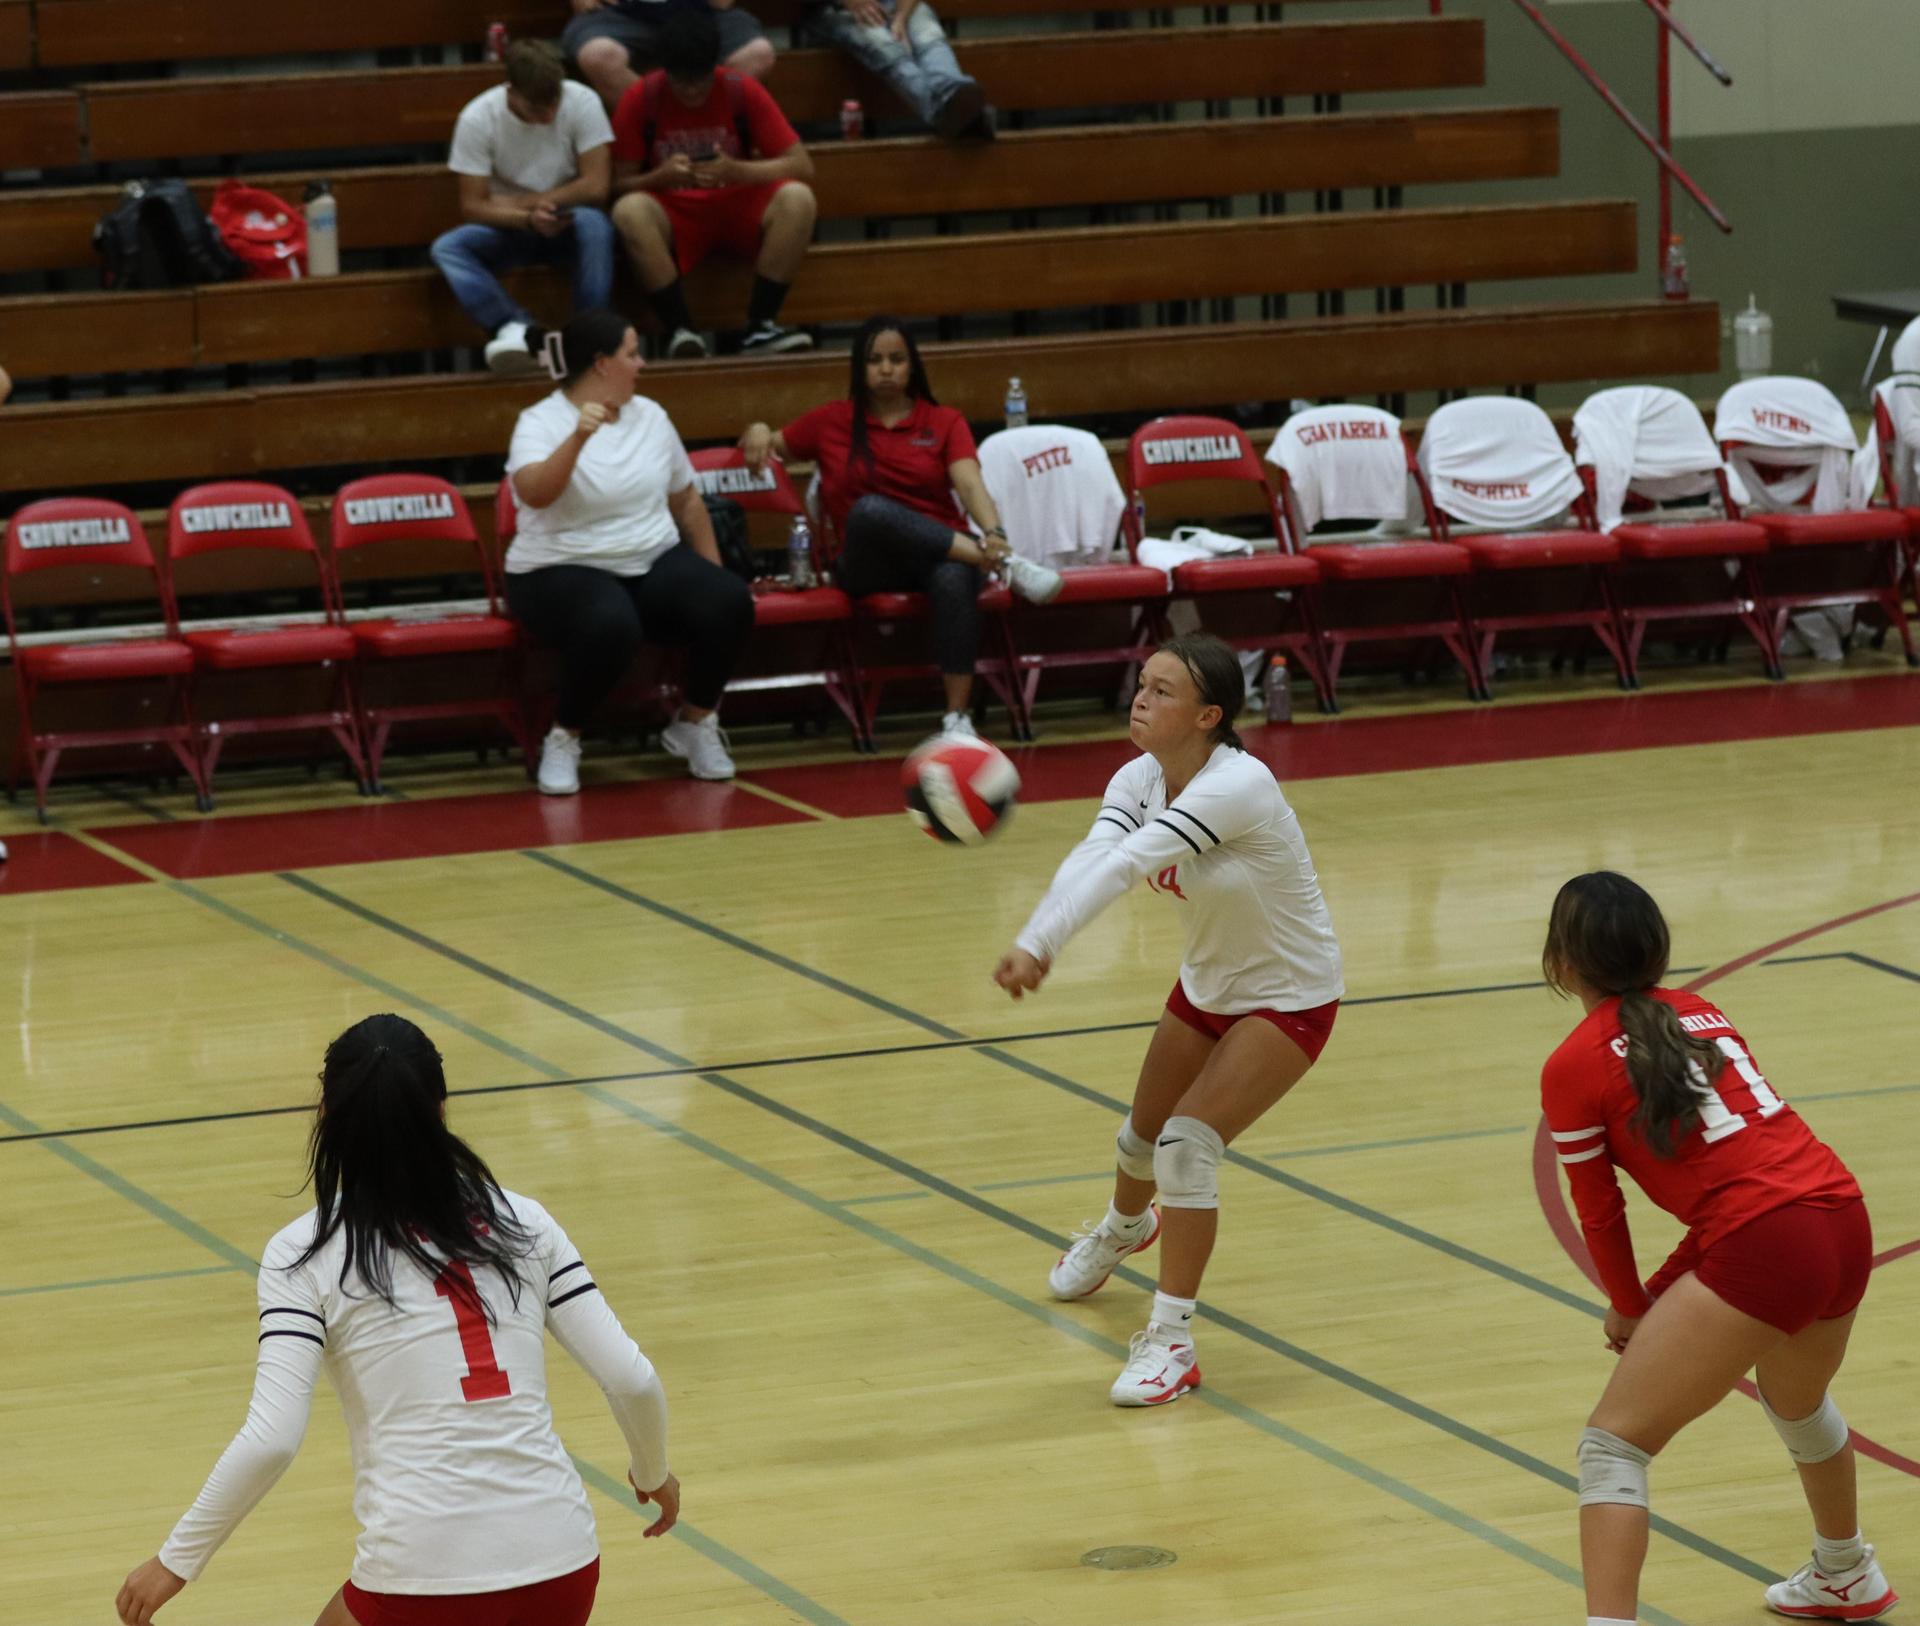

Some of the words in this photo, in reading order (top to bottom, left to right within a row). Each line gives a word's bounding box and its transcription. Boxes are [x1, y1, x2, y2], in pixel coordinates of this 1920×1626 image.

[1141, 434, 1243, 464] CHOWCHILLA
[343, 491, 455, 525] CHOWCHILLA
[1683, 1035, 1786, 1145] 11
[433, 1255, 512, 1402] 1
